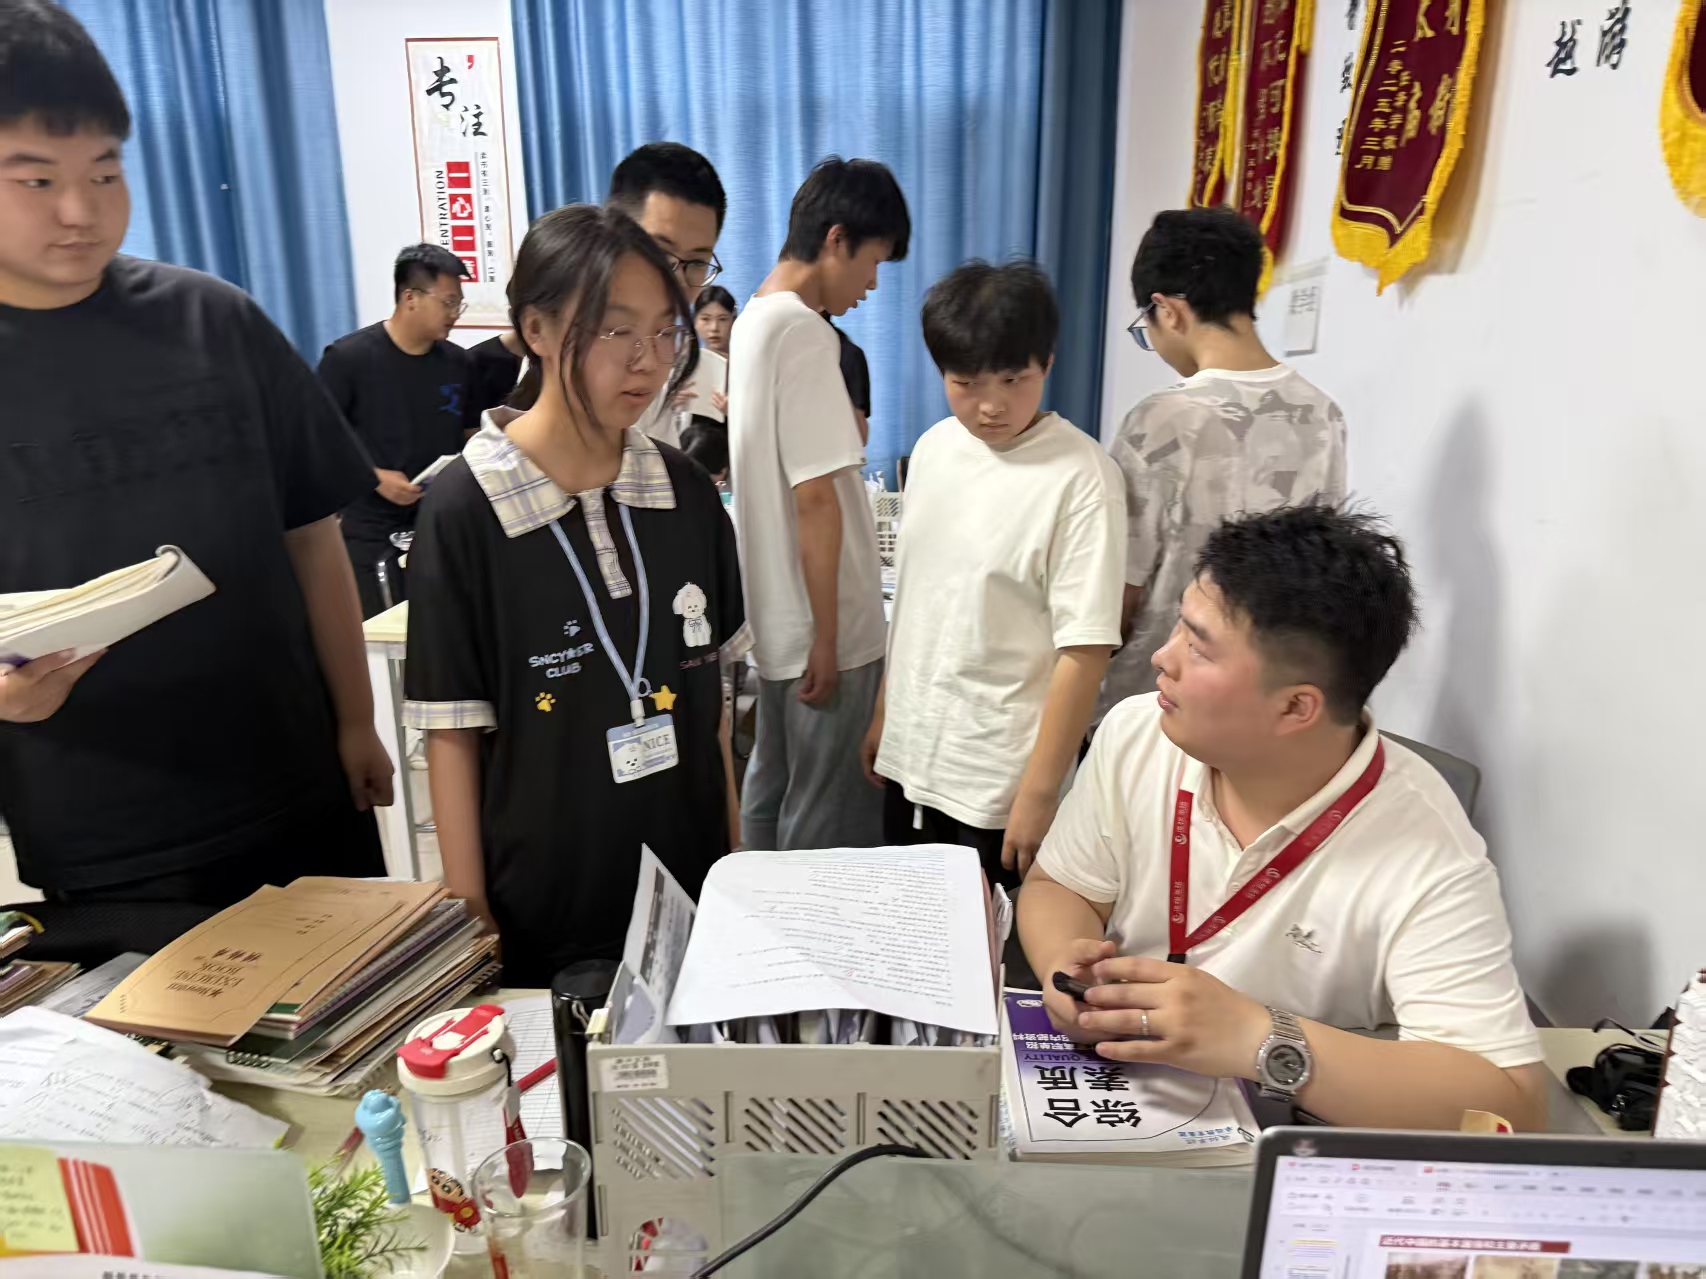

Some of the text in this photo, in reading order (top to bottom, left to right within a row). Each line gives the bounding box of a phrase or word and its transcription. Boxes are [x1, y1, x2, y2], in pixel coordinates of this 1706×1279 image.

[435, 169, 450, 251] ENTRATION
[545, 662, 583, 679] CLUB
[643, 733, 671, 750] NICE
[1023, 1053, 1081, 1062] QUALITY
[1033, 1064, 1129, 1091] 素质
[1042, 1098, 1142, 1128] 综合
